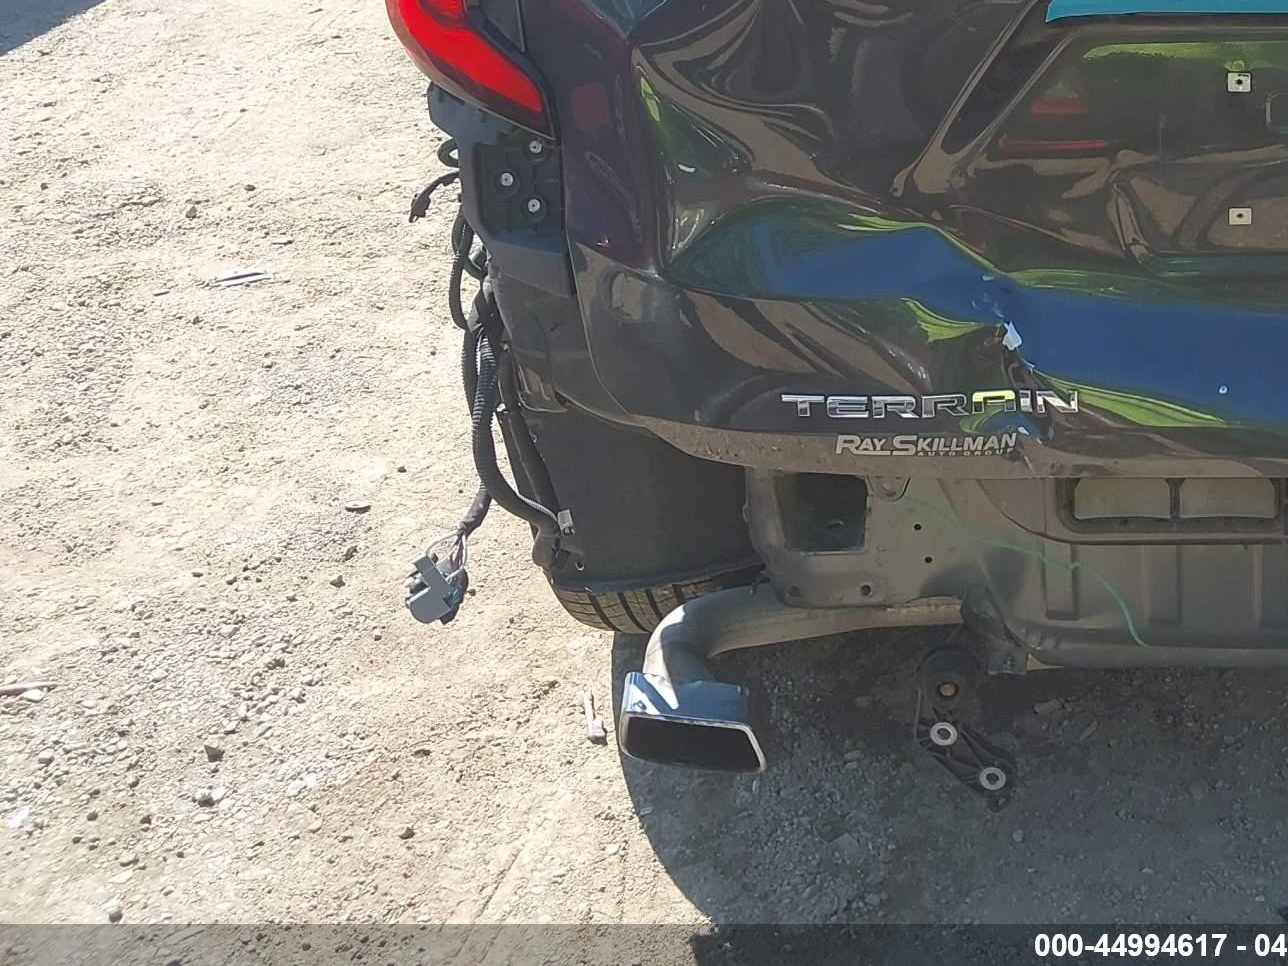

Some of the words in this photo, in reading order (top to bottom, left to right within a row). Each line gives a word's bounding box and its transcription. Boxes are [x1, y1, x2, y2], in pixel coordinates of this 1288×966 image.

[781, 389, 1080, 419] TERRAIN
[835, 435, 891, 455] RAY
[892, 433, 1016, 455] SKILLMAN
